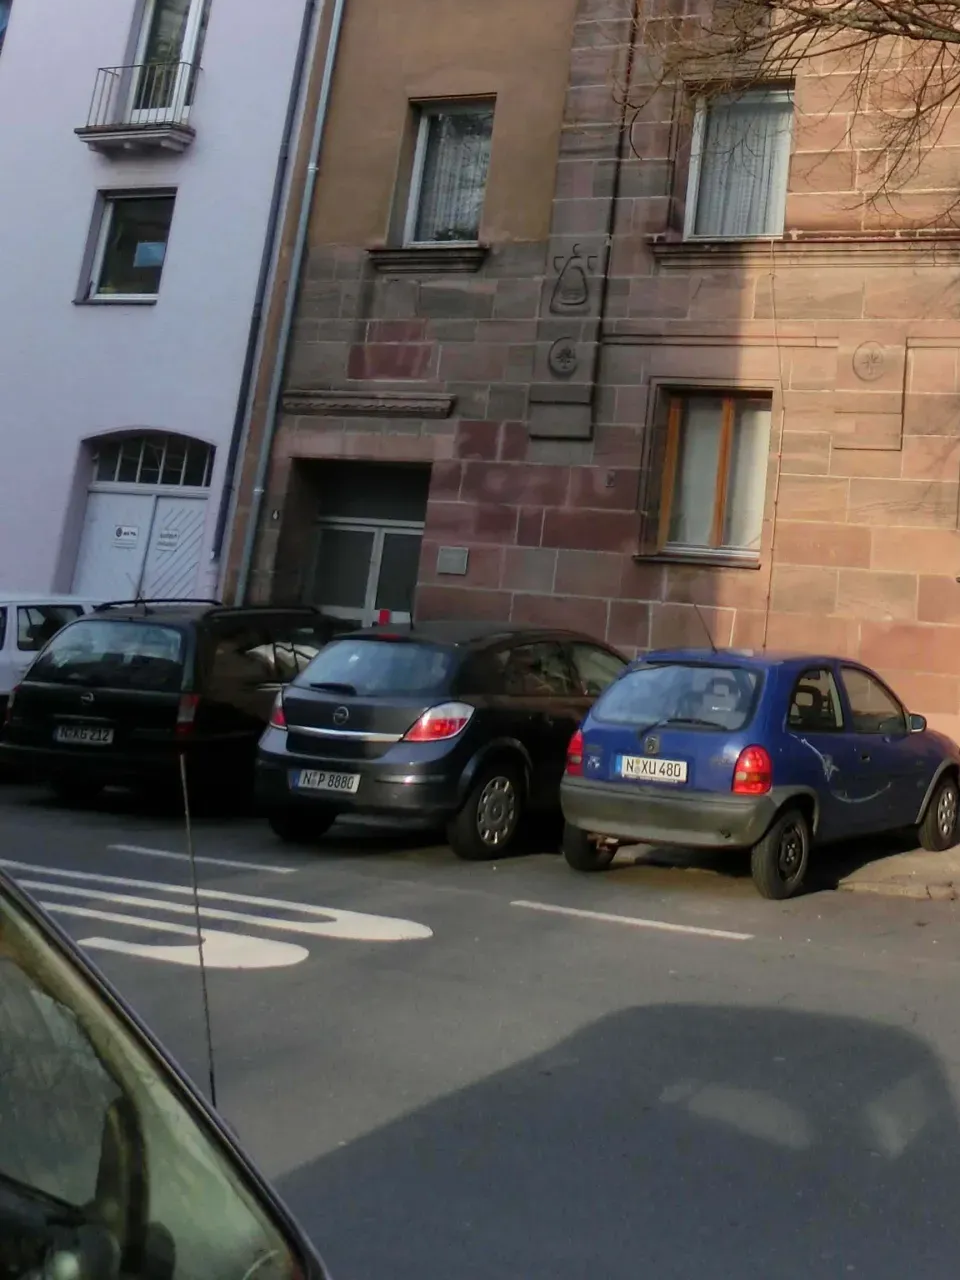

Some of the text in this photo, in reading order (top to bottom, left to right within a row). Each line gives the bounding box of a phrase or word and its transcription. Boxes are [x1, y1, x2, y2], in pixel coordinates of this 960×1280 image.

[626, 758, 681, 777] N XU 480
[303, 771, 312, 785] N
[317, 773, 326, 788] P
